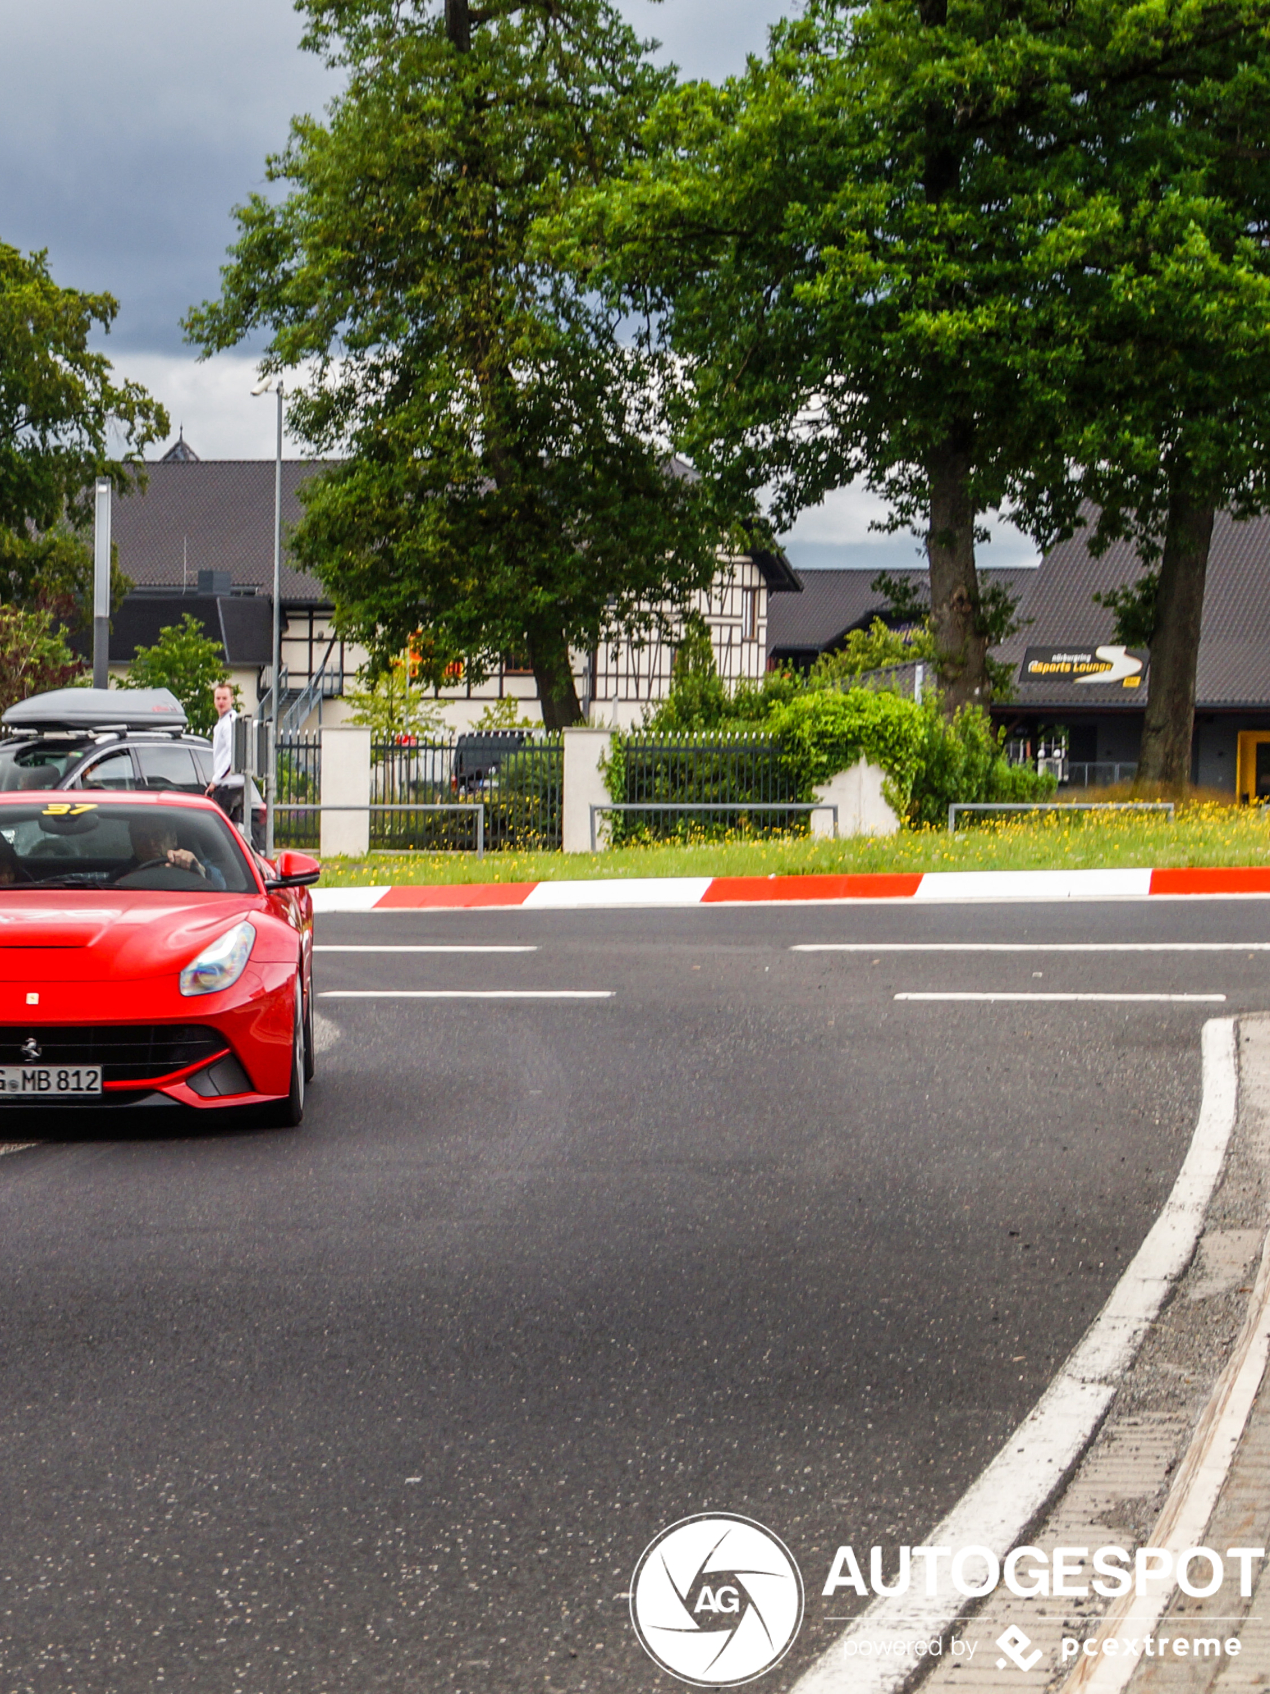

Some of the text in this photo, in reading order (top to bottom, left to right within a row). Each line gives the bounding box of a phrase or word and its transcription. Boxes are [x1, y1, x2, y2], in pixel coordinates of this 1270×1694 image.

[41, 803, 98, 815] 37
[21, 1070, 51, 1091] MB
[57, 1070, 99, 1091] 812
